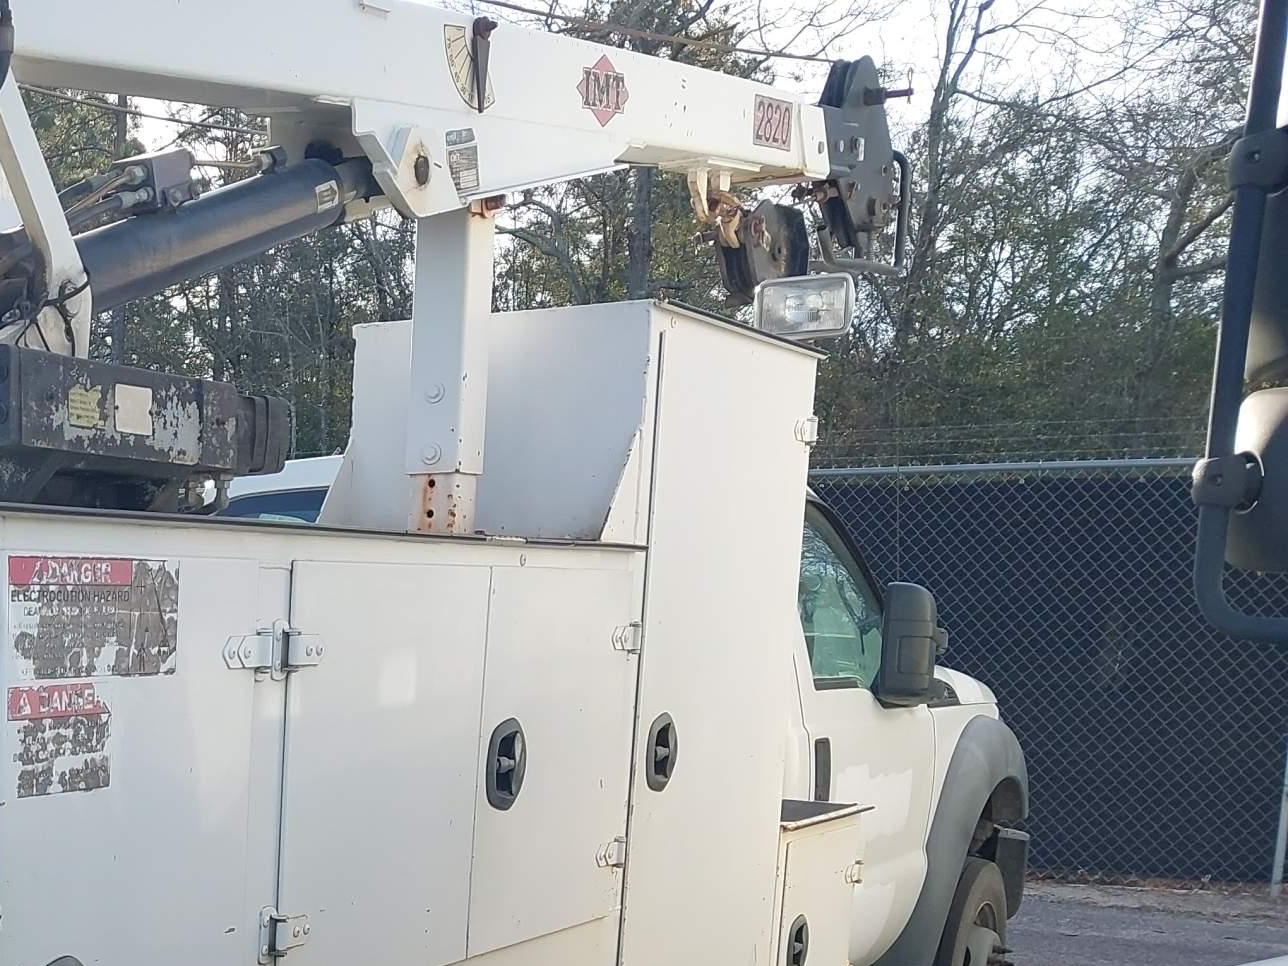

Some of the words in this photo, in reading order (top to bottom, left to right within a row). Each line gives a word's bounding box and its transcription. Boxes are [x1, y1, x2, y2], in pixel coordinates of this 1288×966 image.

[582, 66, 626, 113] IMT
[755, 100, 791, 145] 2820
[10, 589, 91, 603] ELECTROCUTION
[93, 590, 130, 603] HAZARD
